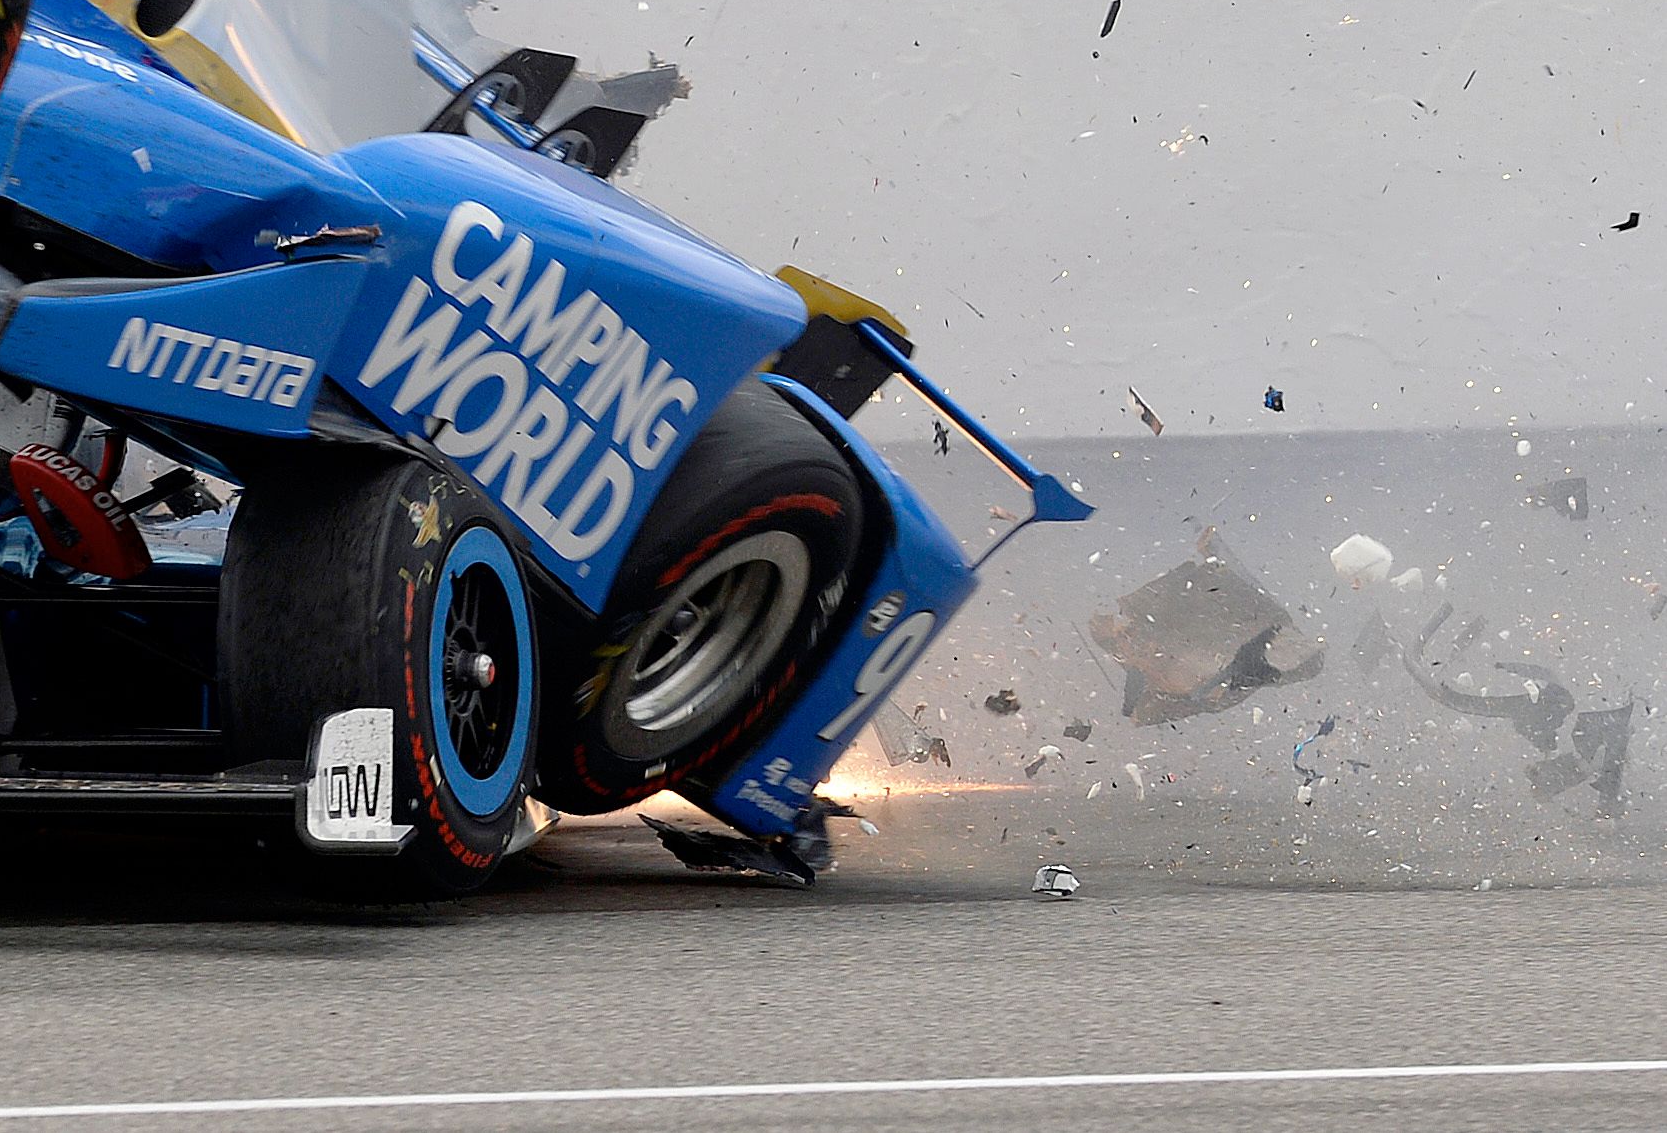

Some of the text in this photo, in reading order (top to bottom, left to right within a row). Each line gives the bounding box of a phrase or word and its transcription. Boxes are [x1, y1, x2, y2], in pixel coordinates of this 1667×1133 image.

[357, 275, 634, 562] WORLD
[433, 200, 698, 469] CAMPING
[17, 444, 127, 532] LUCAS OIL
[817, 611, 935, 742] 9
